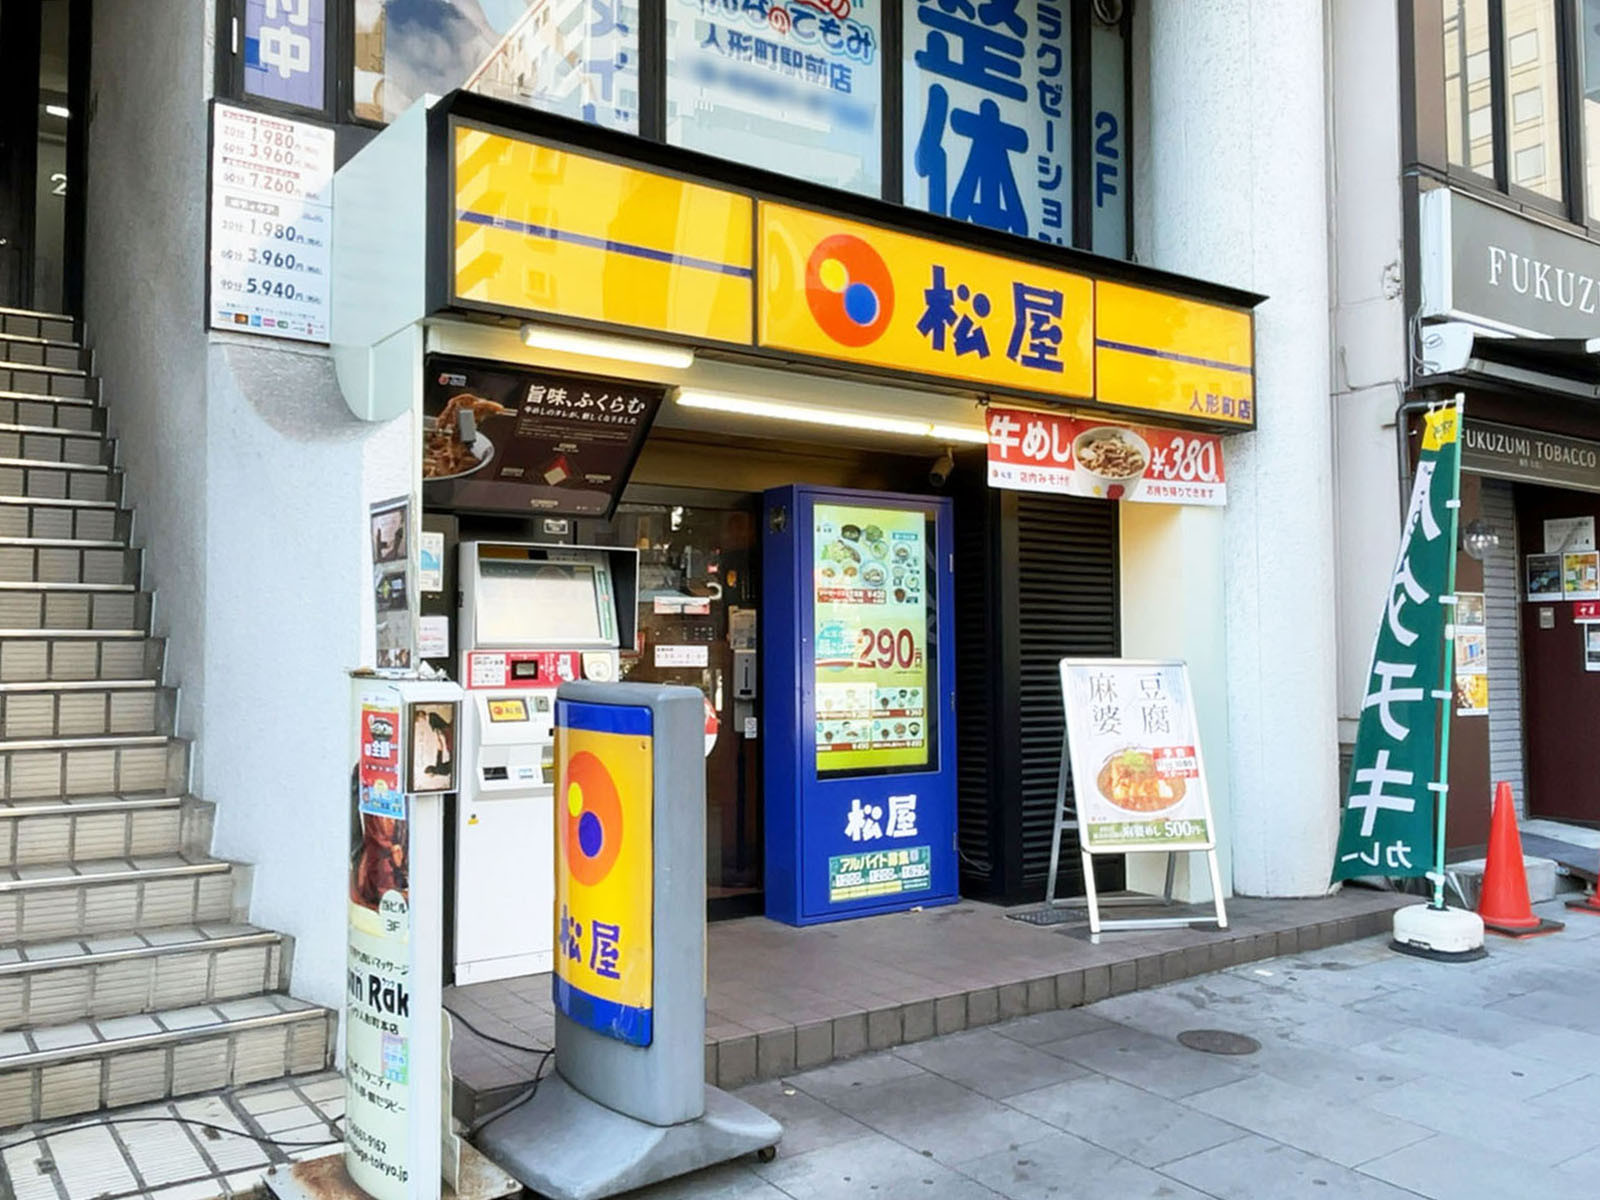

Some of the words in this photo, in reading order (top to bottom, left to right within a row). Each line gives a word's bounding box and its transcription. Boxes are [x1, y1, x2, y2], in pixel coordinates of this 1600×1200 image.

[701, 22, 852, 94] 人形町駅前店
[914, 0, 1029, 238] 整体
[50, 174, 67, 195] 2
[1094, 111, 1119, 209] 2F
[1488, 246, 1600, 314] FUKUZ
[916, 264, 1065, 374] 松屋
[526, 383, 646, 414] 旨味、ふくらむ
[1189, 389, 1251, 419] 人形町店
[989, 414, 1072, 463] 牛めし
[1535, 441, 1597, 468] TOBACCO
[1137, 671, 1171, 735] 豆腐
[843, 794, 919, 842] 松屋
[386, 919, 401, 932] 3F
[558, 903, 621, 981] 松屋
[368, 973, 409, 1018] Rak
